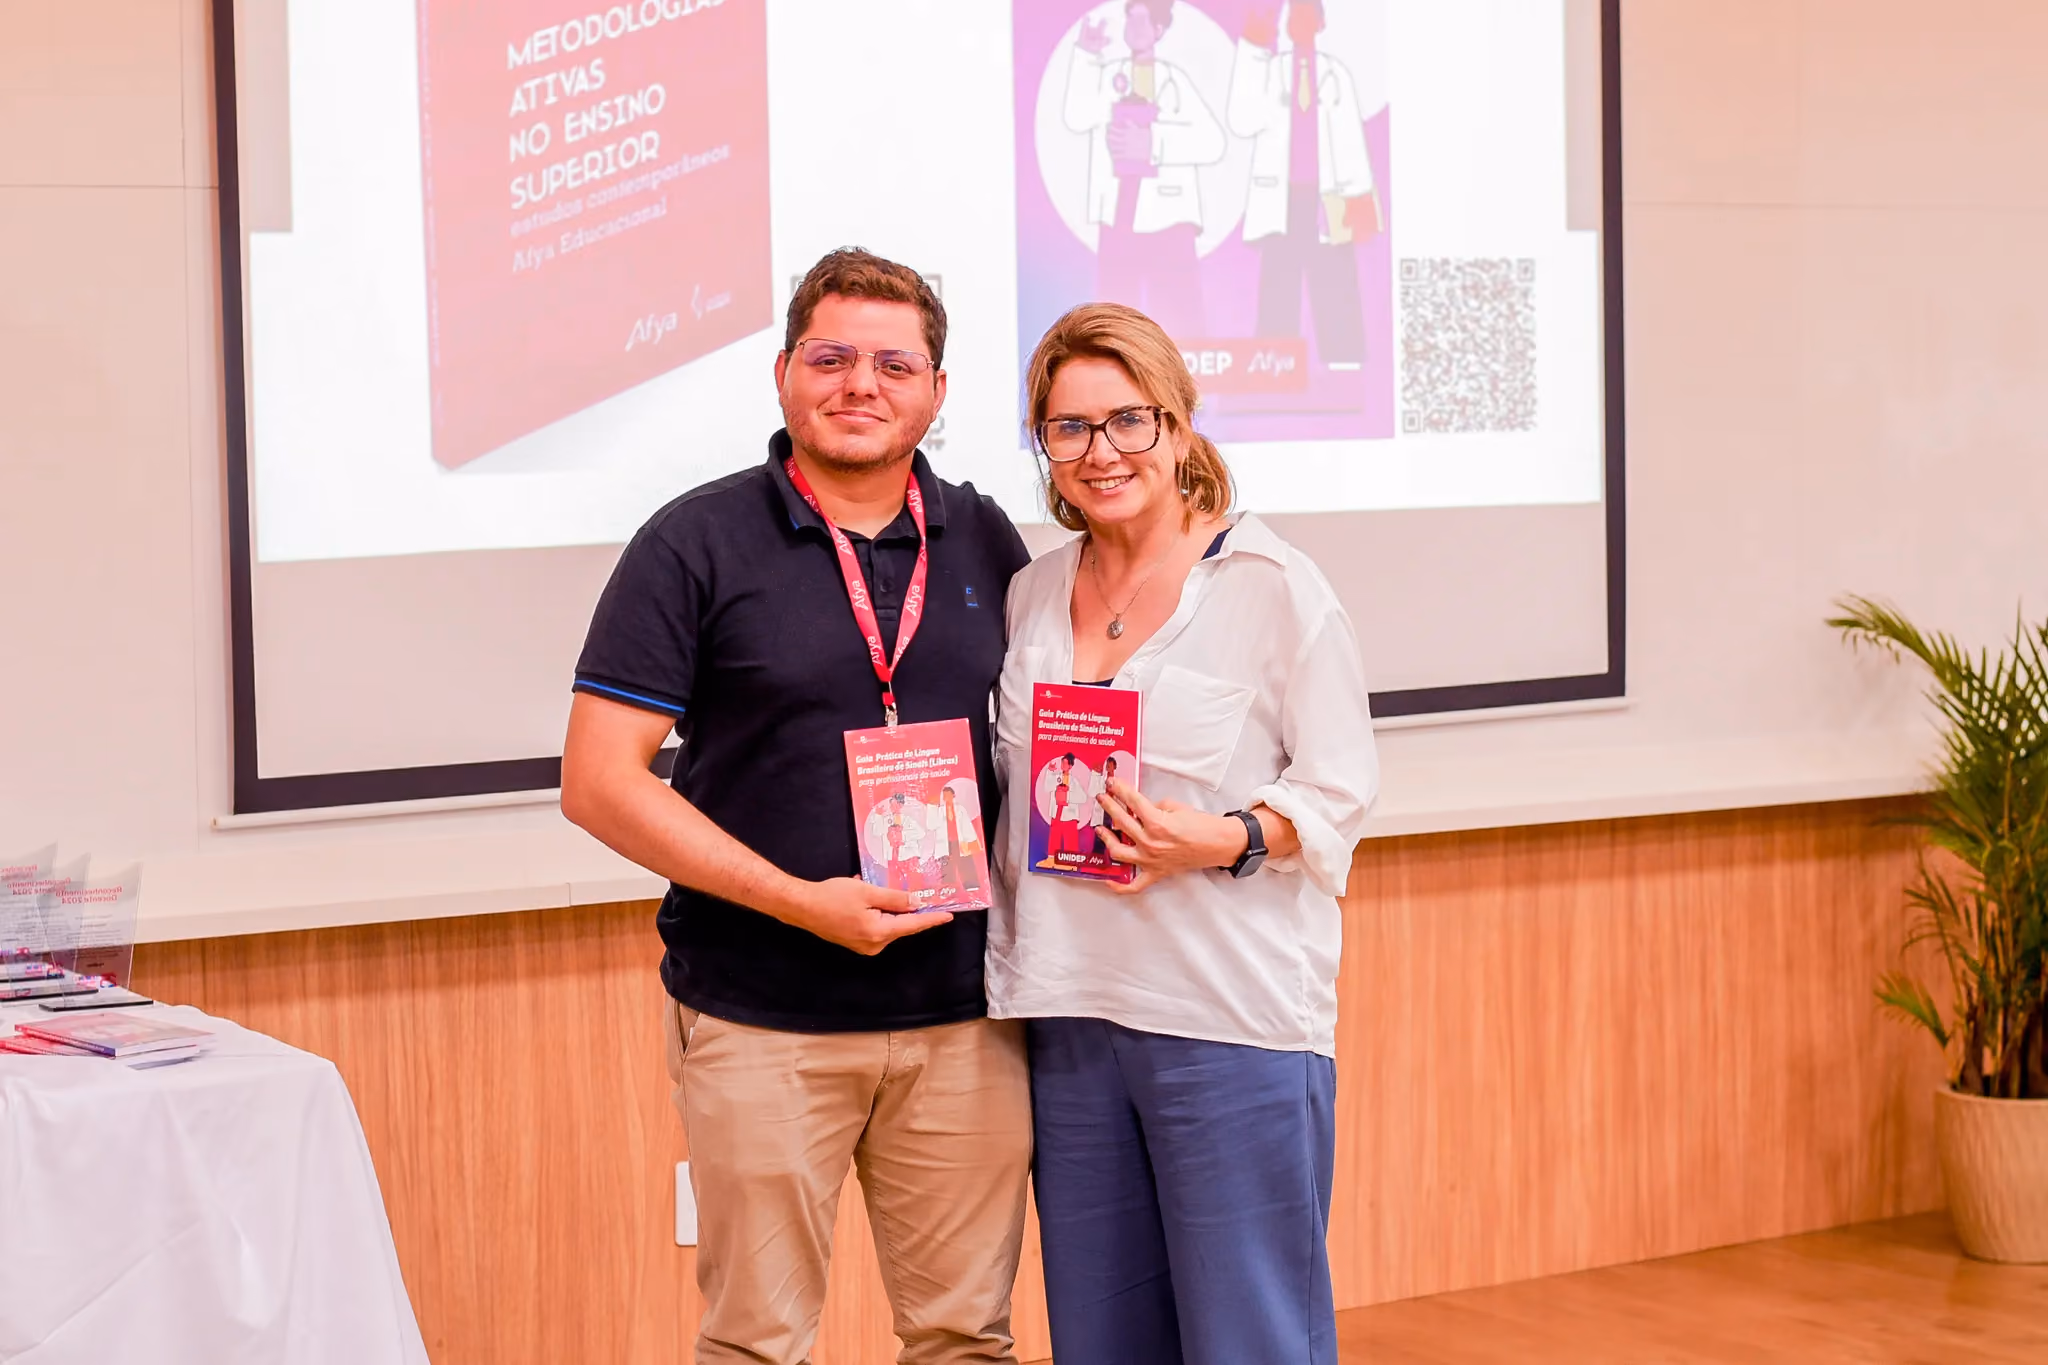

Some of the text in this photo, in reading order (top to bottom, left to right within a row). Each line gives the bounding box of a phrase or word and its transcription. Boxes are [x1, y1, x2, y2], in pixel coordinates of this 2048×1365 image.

[507, 0, 726, 70] METODOLOGI
[509, 58, 606, 118] ATIVAS
[509, 84, 666, 162] NO ENSINO
[510, 130, 660, 209] SUPERIOR
[511, 200, 583, 236] estudos
[512, 197, 667, 272] Afya Educacional
[625, 311, 678, 352] Afya
[1181, 350, 1295, 377] DEP Afya
[853, 580, 869, 611] Afya
[906, 585, 922, 617] Afya
[867, 635, 884, 666] Afya
[1038, 709, 1054, 718] Guia
[1056, 710, 1080, 720] Prática
[1079, 712, 1088, 721] de
[1038, 720, 1070, 731] Brasileira
[1079, 725, 1098, 734] Sinais
[1038, 733, 1052, 741] para
[1053, 734, 1089, 744] profissionais
[1098, 738, 1116, 747] saúde
[856, 755, 873, 764] Guia
[876, 750, 903, 762] Prática
[904, 750, 913, 759] de
[857, 763, 894, 775] Brasileira
[895, 762, 904, 771] de
[905, 758, 928, 770] Sinais
[858, 767, 950, 787] para profissionais da saúde
[1058, 852, 1104, 865] UNIDEP Afya
